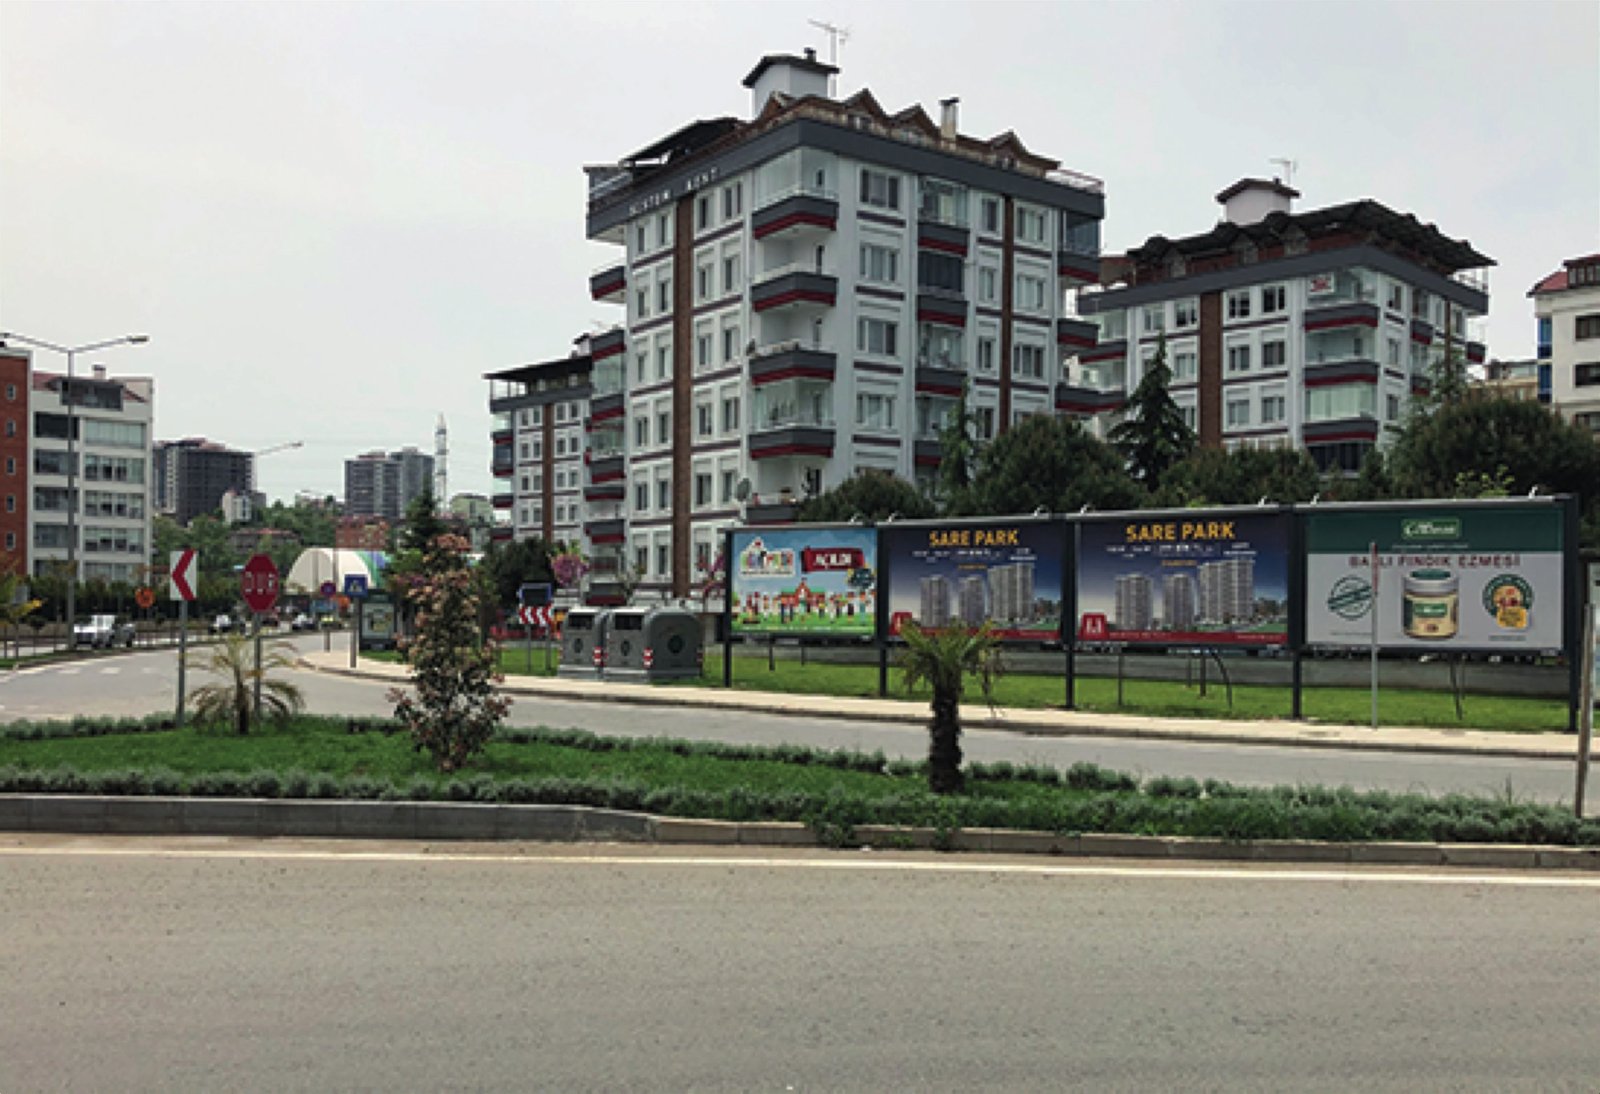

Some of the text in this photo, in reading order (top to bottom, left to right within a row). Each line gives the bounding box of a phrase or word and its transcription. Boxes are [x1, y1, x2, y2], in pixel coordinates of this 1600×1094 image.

[929, 528, 1019, 547] SARE PARK
[1127, 521, 1236, 543] SARE PARK
